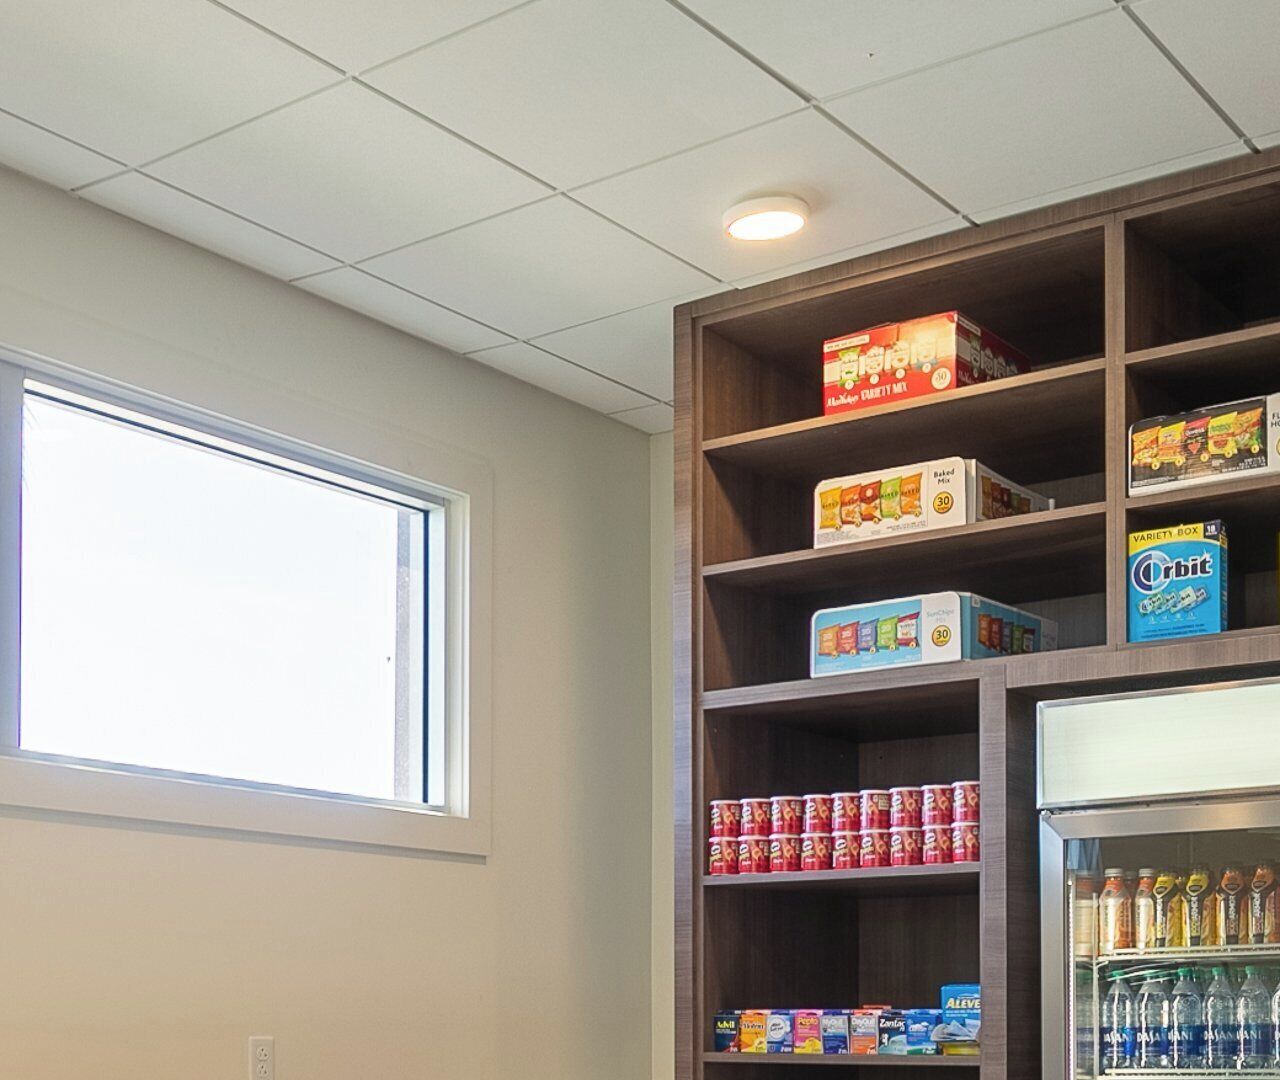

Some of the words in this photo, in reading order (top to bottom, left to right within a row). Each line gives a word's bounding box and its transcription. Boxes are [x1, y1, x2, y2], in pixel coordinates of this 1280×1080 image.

[933, 468, 955, 478] Baked
[938, 477, 951, 485] Mix
[937, 496, 950, 507] 30
[1133, 531, 1173, 543] VARIETY
[1177, 526, 1199, 535] BOX
[1206, 525, 1216, 533] 18
[1132, 549, 1213, 595] Orbit
[936, 628, 949, 640] 30
[946, 998, 980, 1009] ALEVE
[880, 1019, 906, 1028] Zantac
